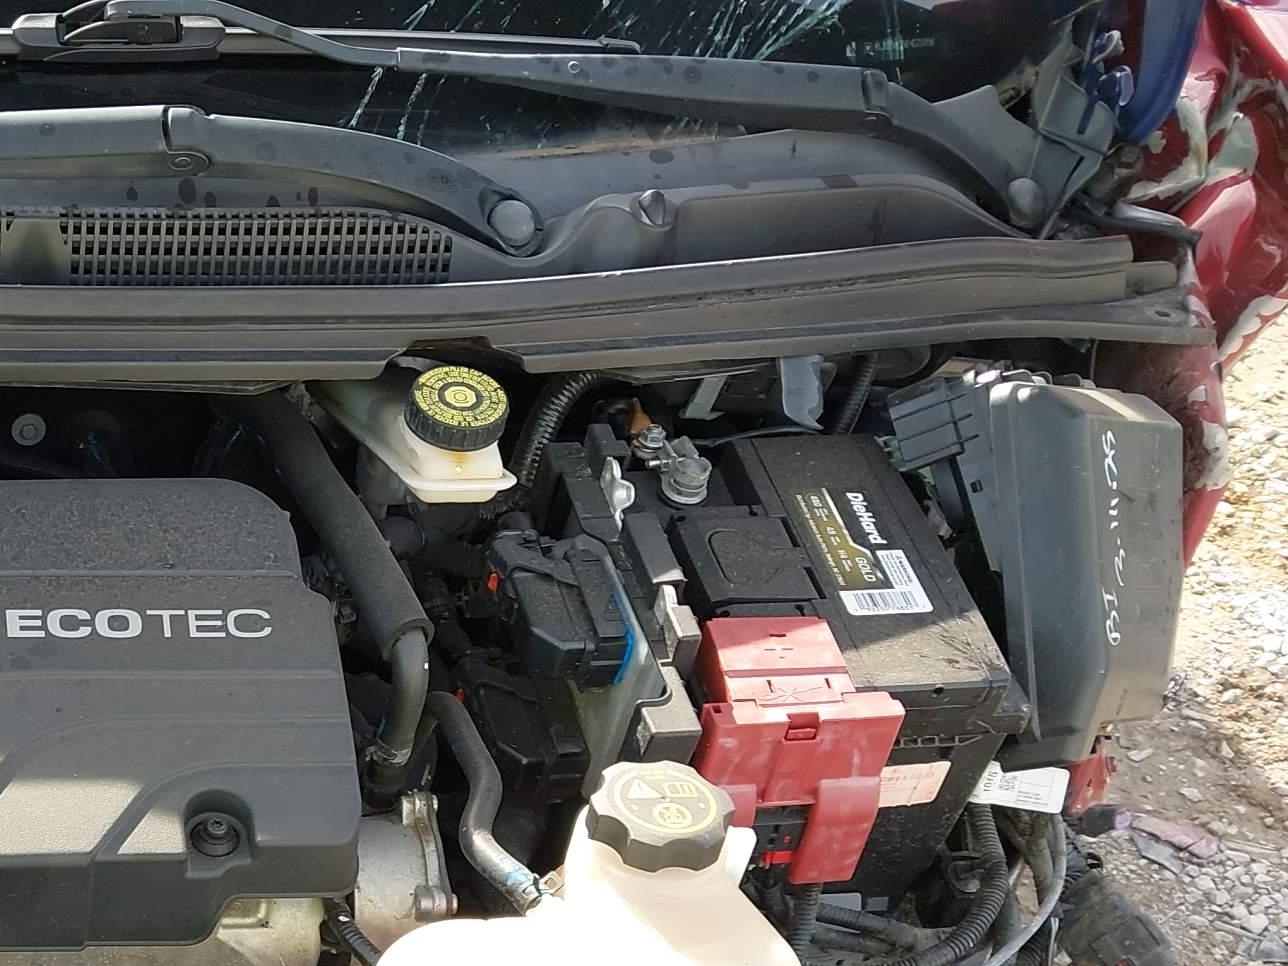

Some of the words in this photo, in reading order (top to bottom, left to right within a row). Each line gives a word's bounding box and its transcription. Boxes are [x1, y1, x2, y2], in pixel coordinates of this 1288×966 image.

[844, 491, 889, 545] DieHard
[854, 556, 878, 582] GOLD
[5, 608, 273, 639] ECOTEC
